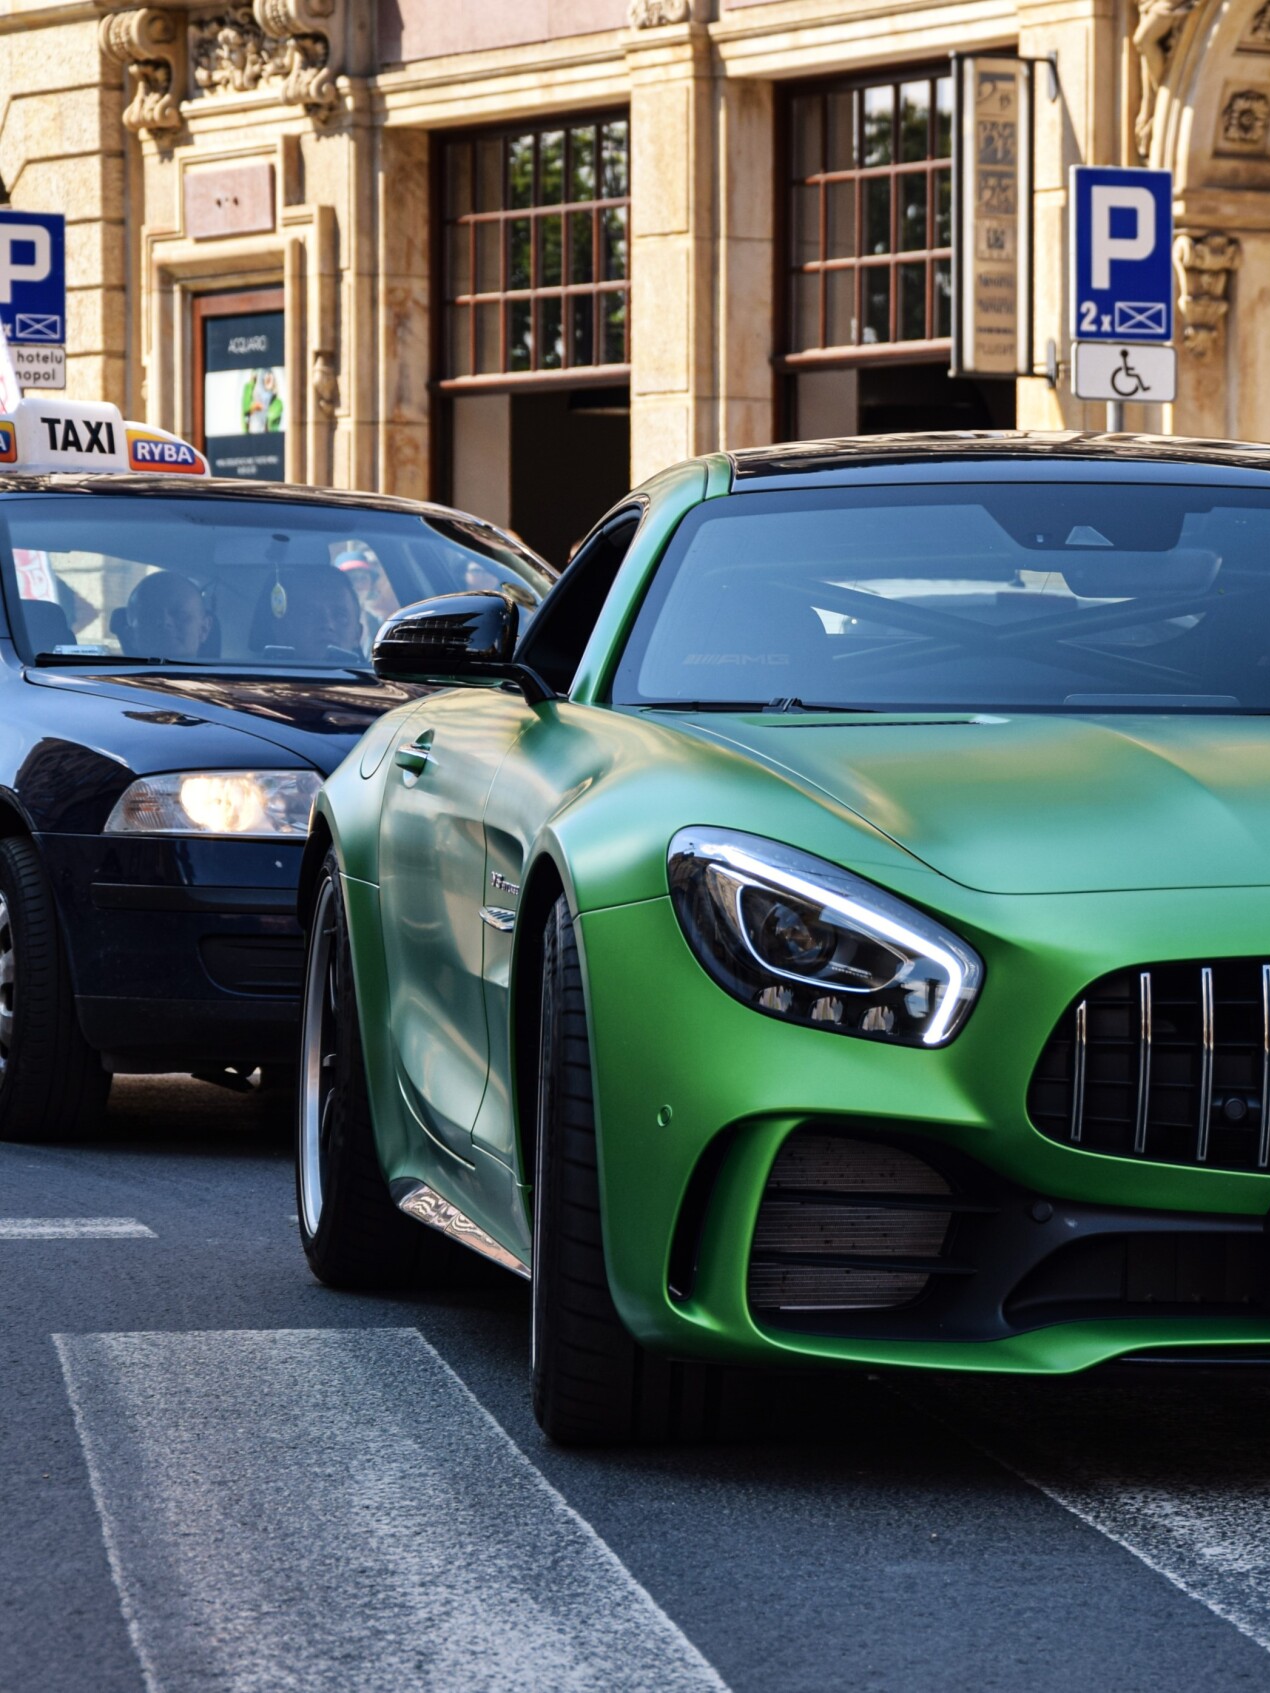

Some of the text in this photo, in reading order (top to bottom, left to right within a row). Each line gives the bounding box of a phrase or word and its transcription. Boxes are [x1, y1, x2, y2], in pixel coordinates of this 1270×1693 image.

[1091, 185, 1155, 290] P
[0, 222, 51, 304] P
[17, 350, 63, 364] hotelu
[41, 417, 116, 454] TAXI
[136, 442, 193, 463] RYBA
